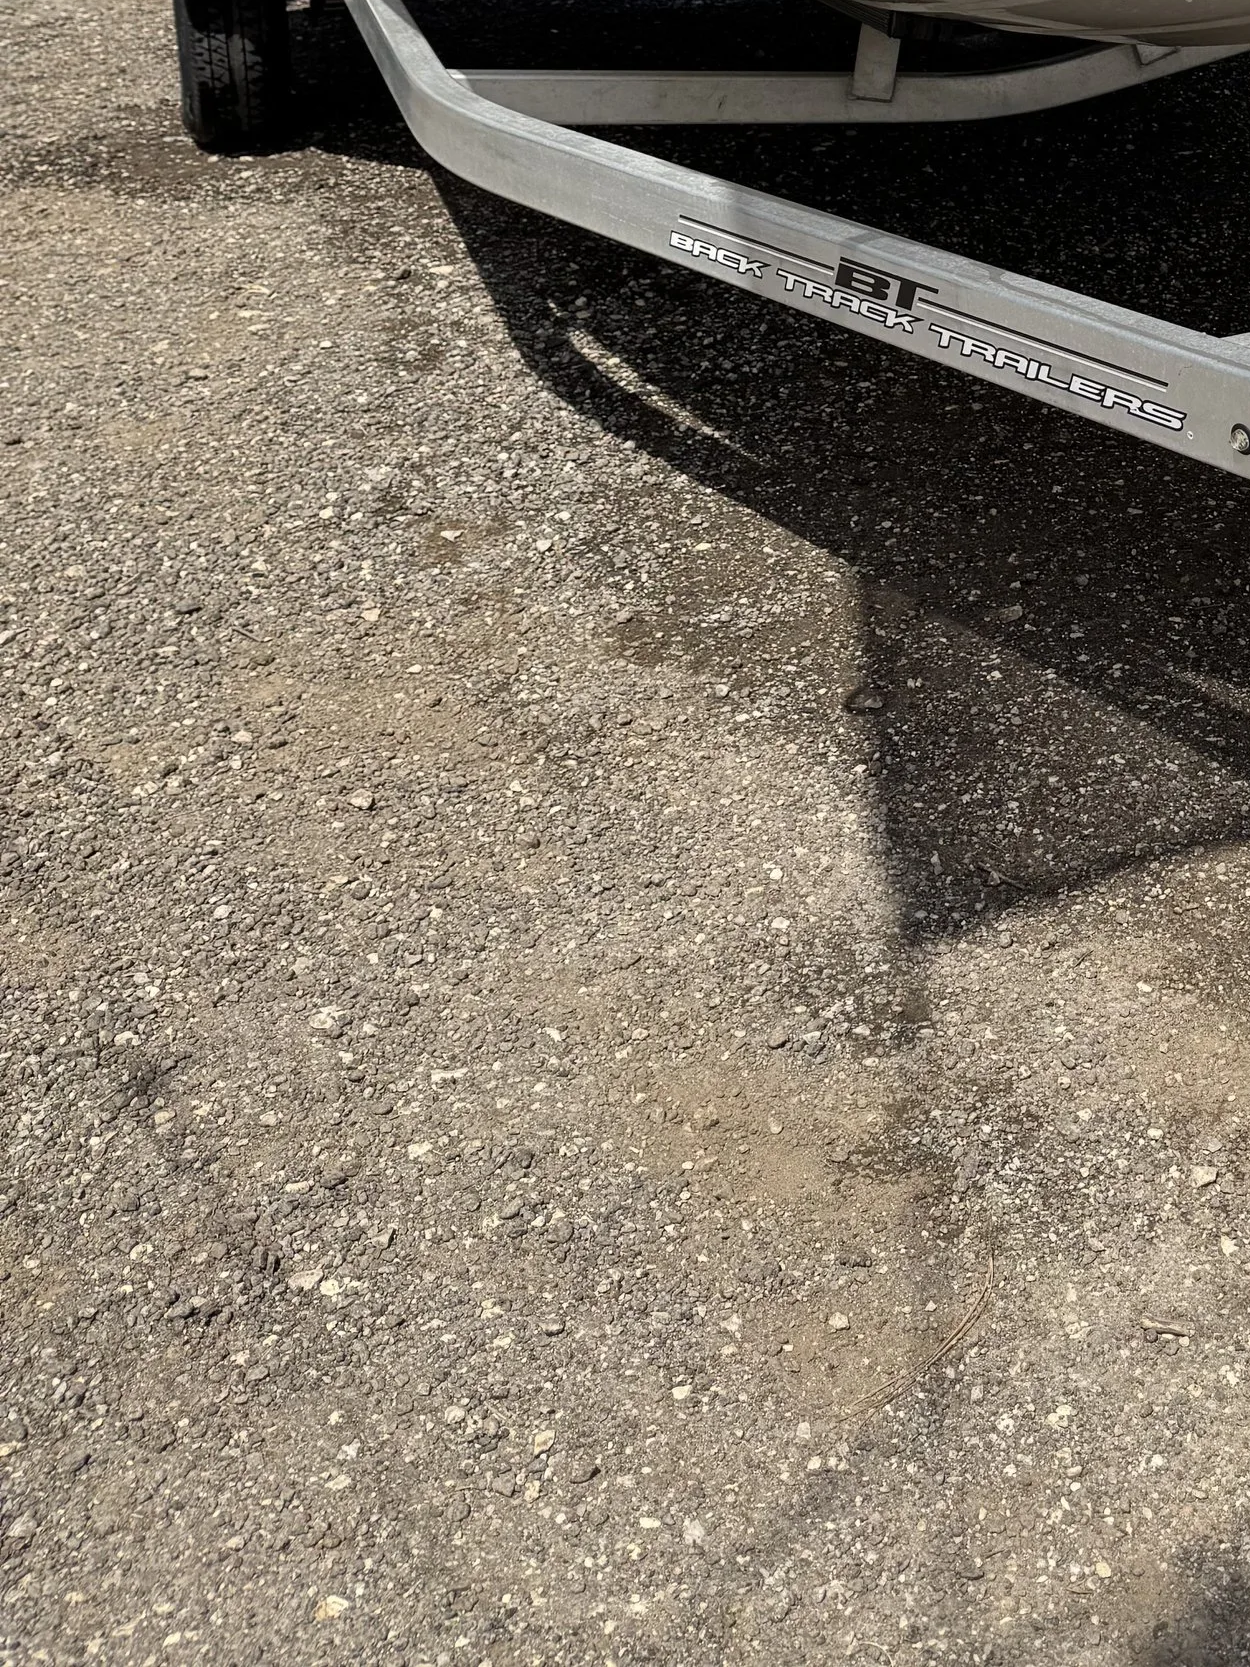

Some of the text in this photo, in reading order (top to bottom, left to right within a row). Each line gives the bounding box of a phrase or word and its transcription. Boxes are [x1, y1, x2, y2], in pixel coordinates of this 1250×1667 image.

[669, 230, 1188, 432] BACK TRACK TRAILERS
[835, 256, 939, 311] BT
